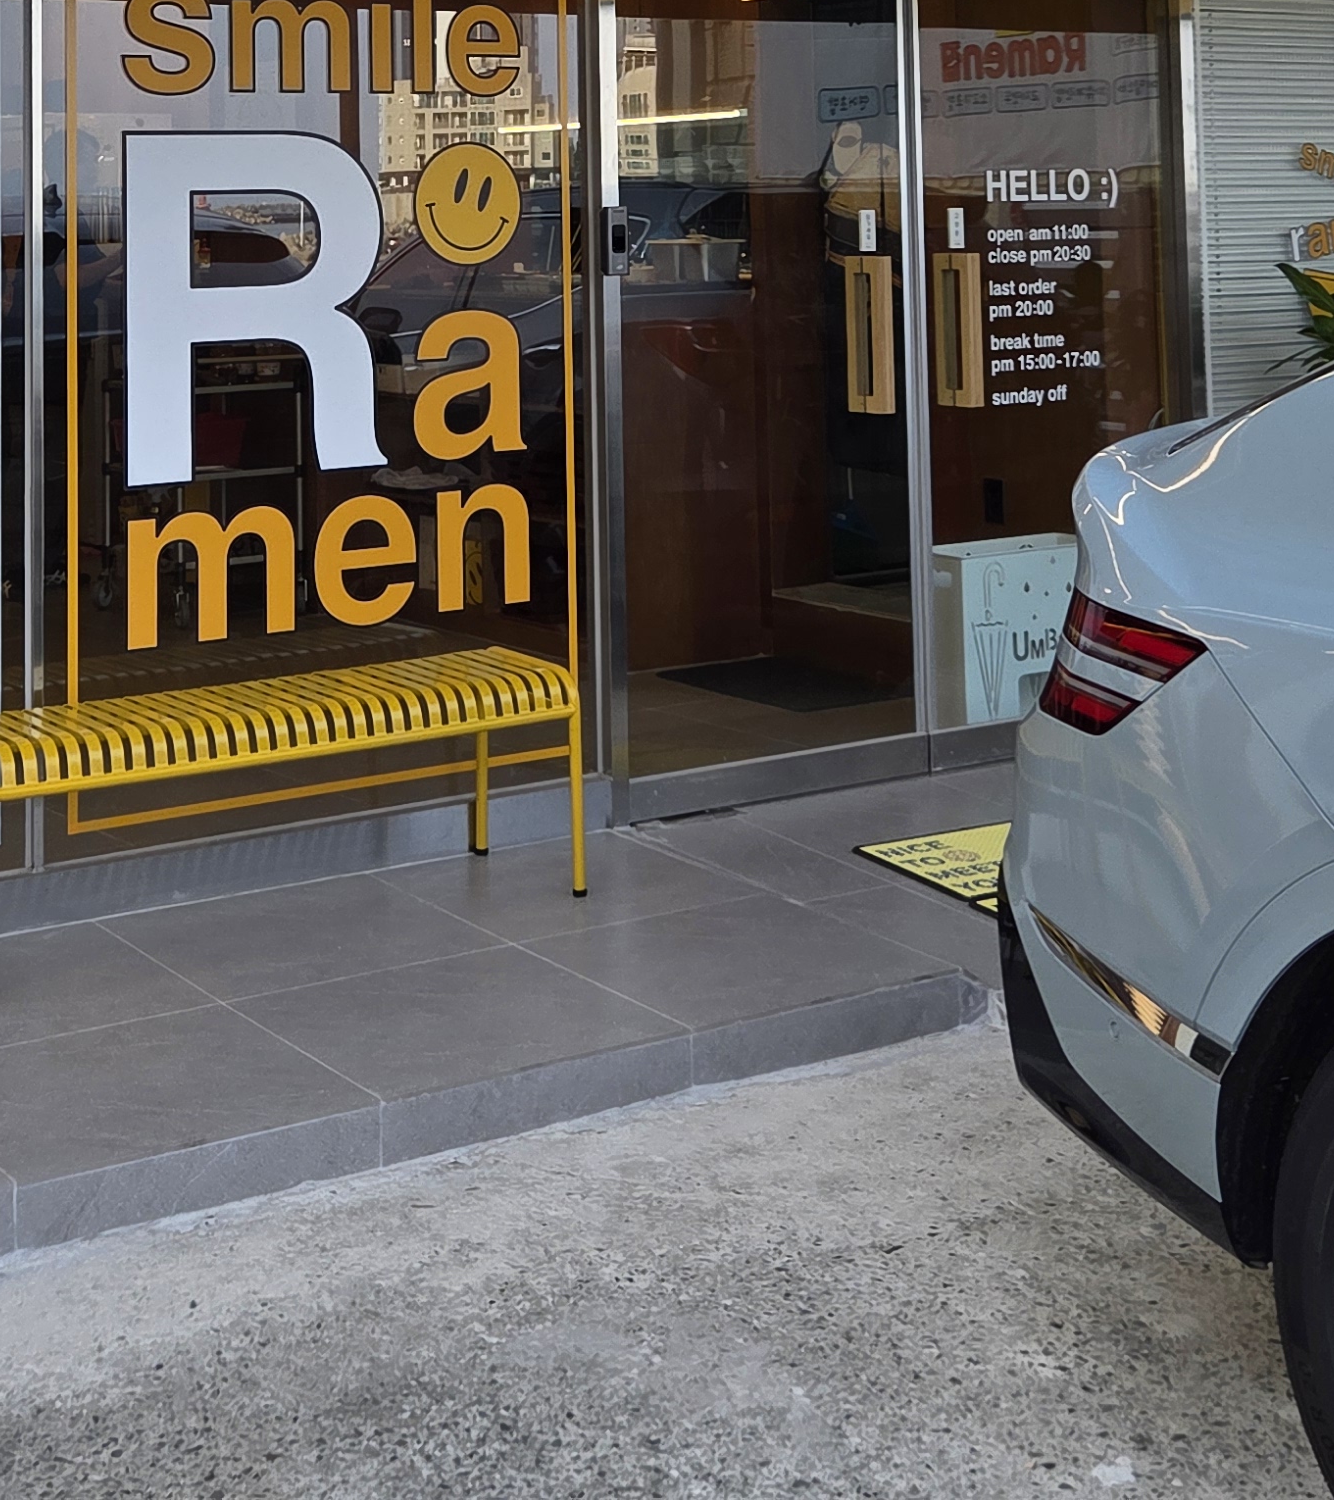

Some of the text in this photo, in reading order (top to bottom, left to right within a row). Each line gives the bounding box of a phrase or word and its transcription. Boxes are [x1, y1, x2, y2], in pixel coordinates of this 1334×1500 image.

[985, 169, 1090, 202] HELLO
[987, 225, 1023, 244] open
[987, 247, 1027, 264] close
[989, 279, 1057, 297] last order
[989, 300, 1054, 321] pm 20:00
[990, 333, 1065, 351] break time
[991, 351, 1101, 376] pm 15:00-17:00
[992, 385, 1068, 407] sunday off
[876, 840, 953, 858] NICE
[898, 856, 946, 868] TO
